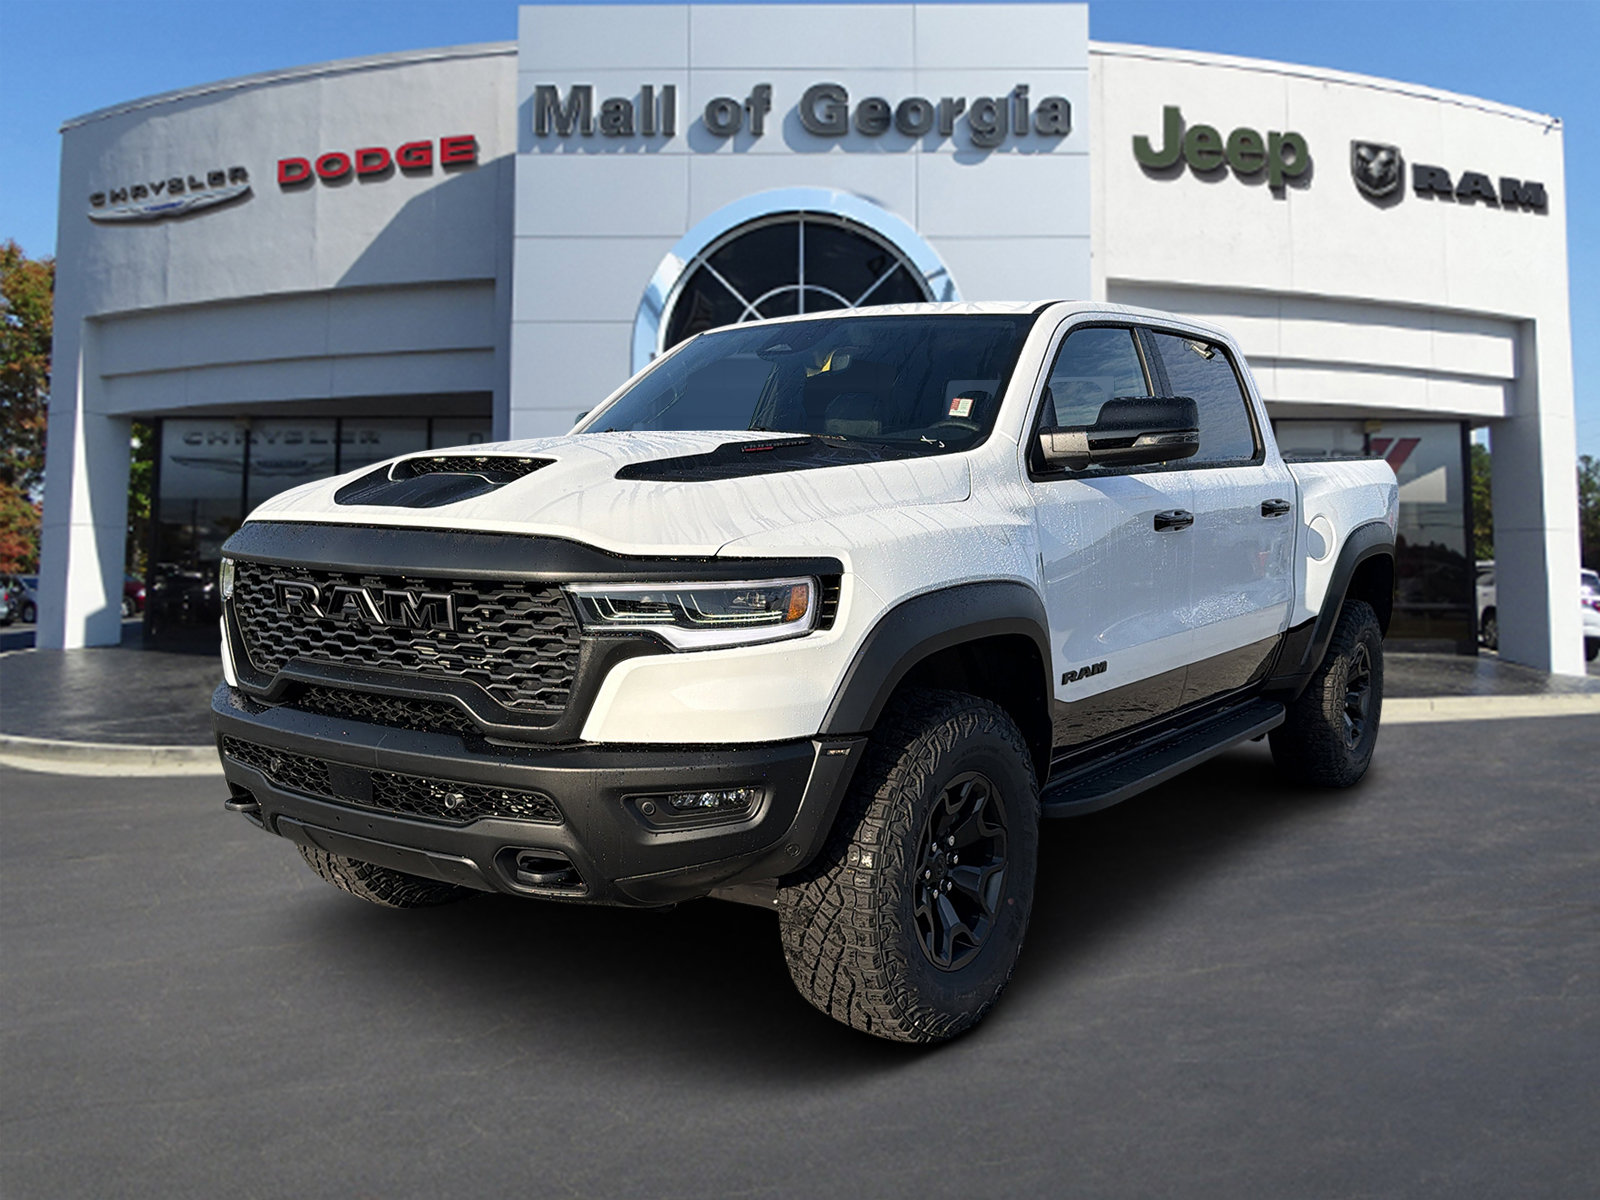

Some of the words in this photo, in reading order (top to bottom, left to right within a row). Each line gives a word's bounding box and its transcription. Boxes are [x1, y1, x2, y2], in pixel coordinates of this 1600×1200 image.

[533, 84, 677, 138] Mall
[703, 84, 772, 137] of
[800, 83, 1073, 148] Georgia
[277, 134, 478, 188] DODGE
[1132, 105, 1309, 188] Jeep
[89, 166, 249, 207] CHRYSLER
[1411, 162, 1548, 212] RAM
[273, 578, 458, 632] RAM
[1061, 660, 1108, 686] RAM
